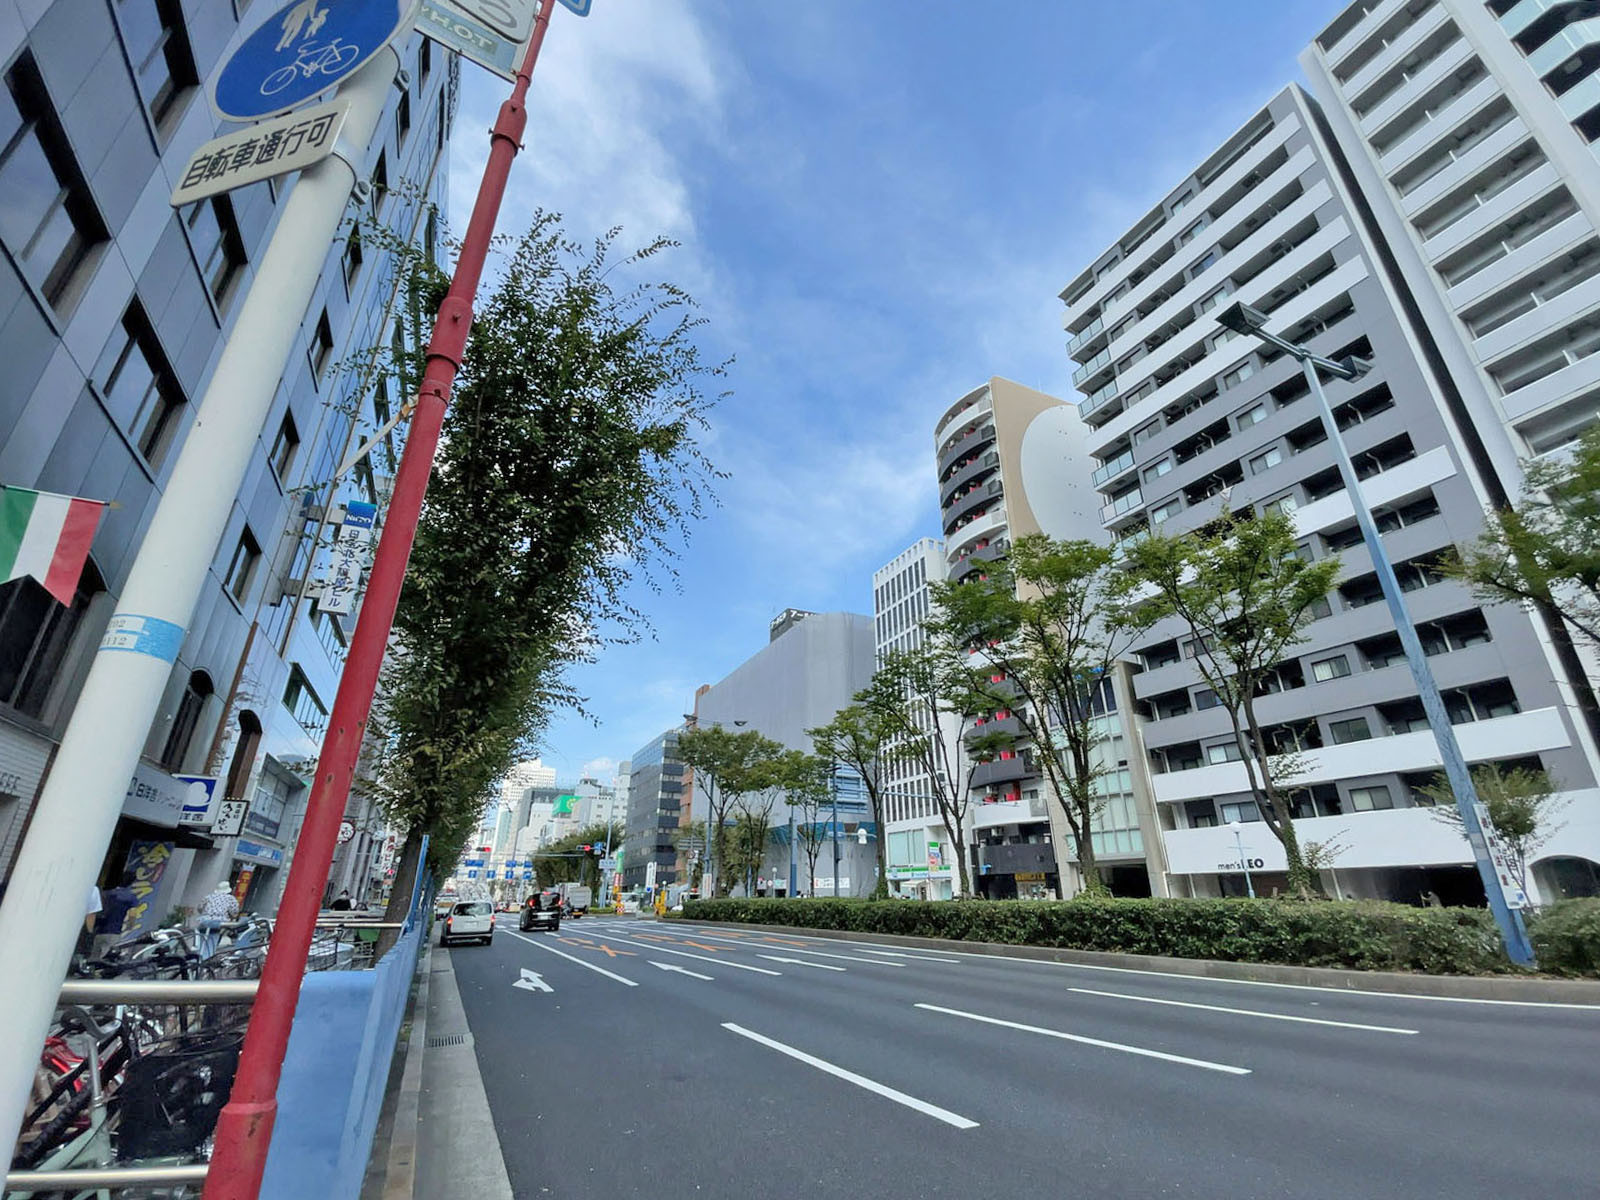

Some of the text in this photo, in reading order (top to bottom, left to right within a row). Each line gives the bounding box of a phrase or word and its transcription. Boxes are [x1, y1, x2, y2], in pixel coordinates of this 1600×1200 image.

[181, 112, 338, 190] 自転車通行可
[1218, 858, 1264, 870] men's LEO
